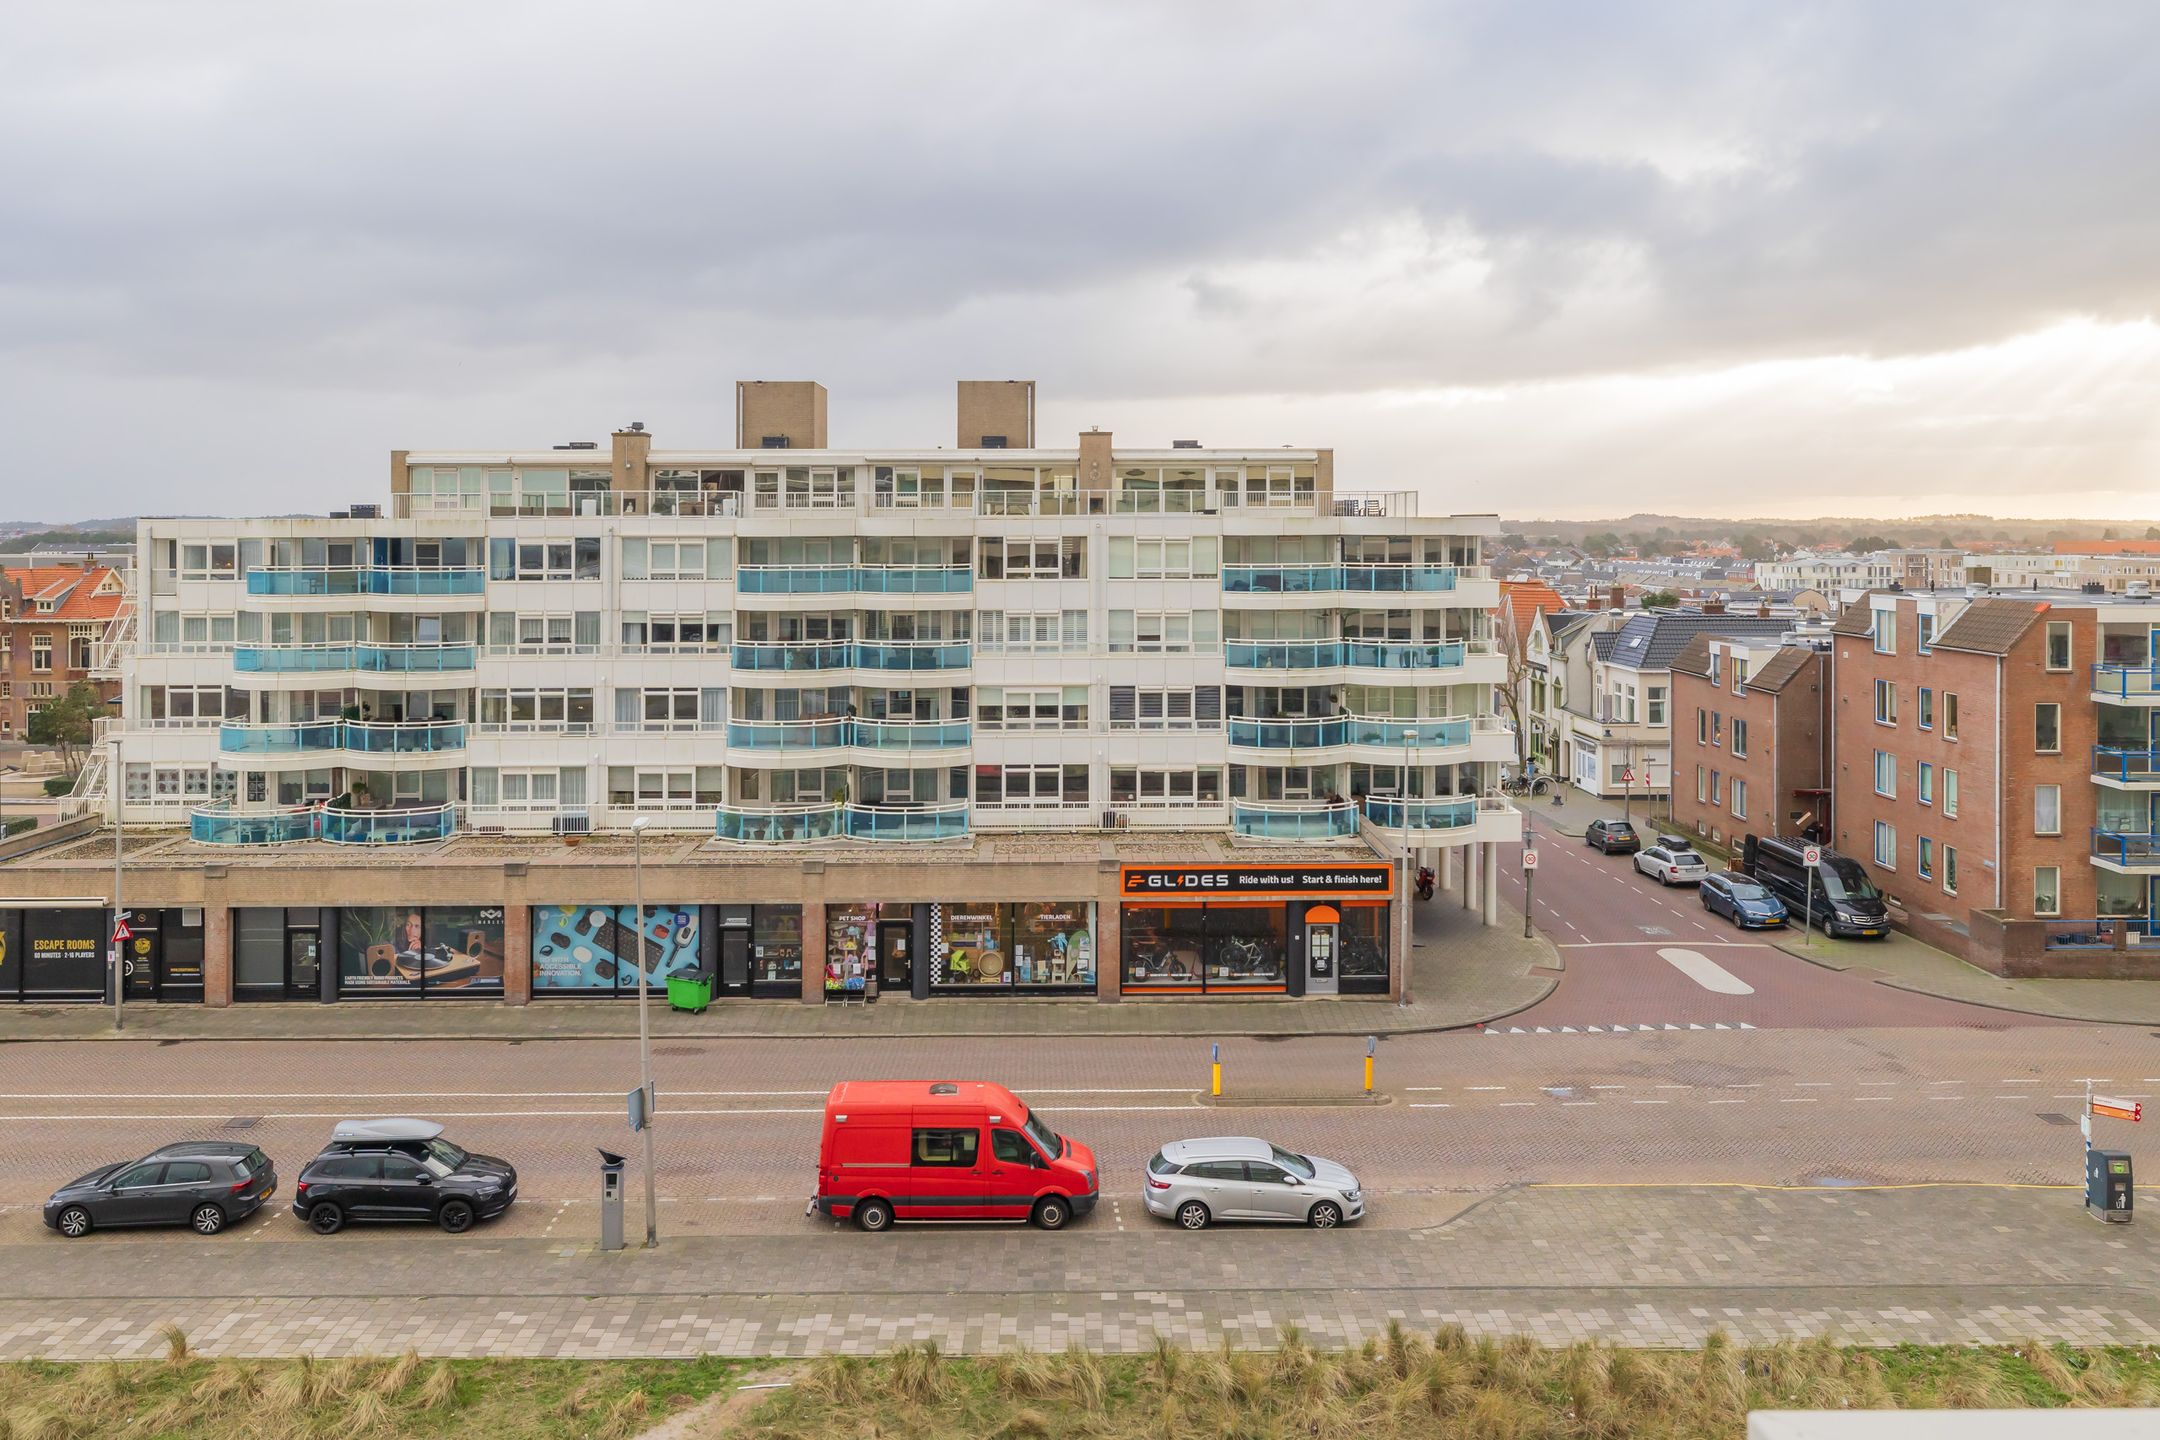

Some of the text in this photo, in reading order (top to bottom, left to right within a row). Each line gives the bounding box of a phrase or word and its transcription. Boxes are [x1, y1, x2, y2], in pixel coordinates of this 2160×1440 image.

[1239, 876, 1294, 884] Ride with us!
[1302, 875, 1382, 884] Start & finish here!
[34, 940, 96, 950] ESCAPE ROOMS
